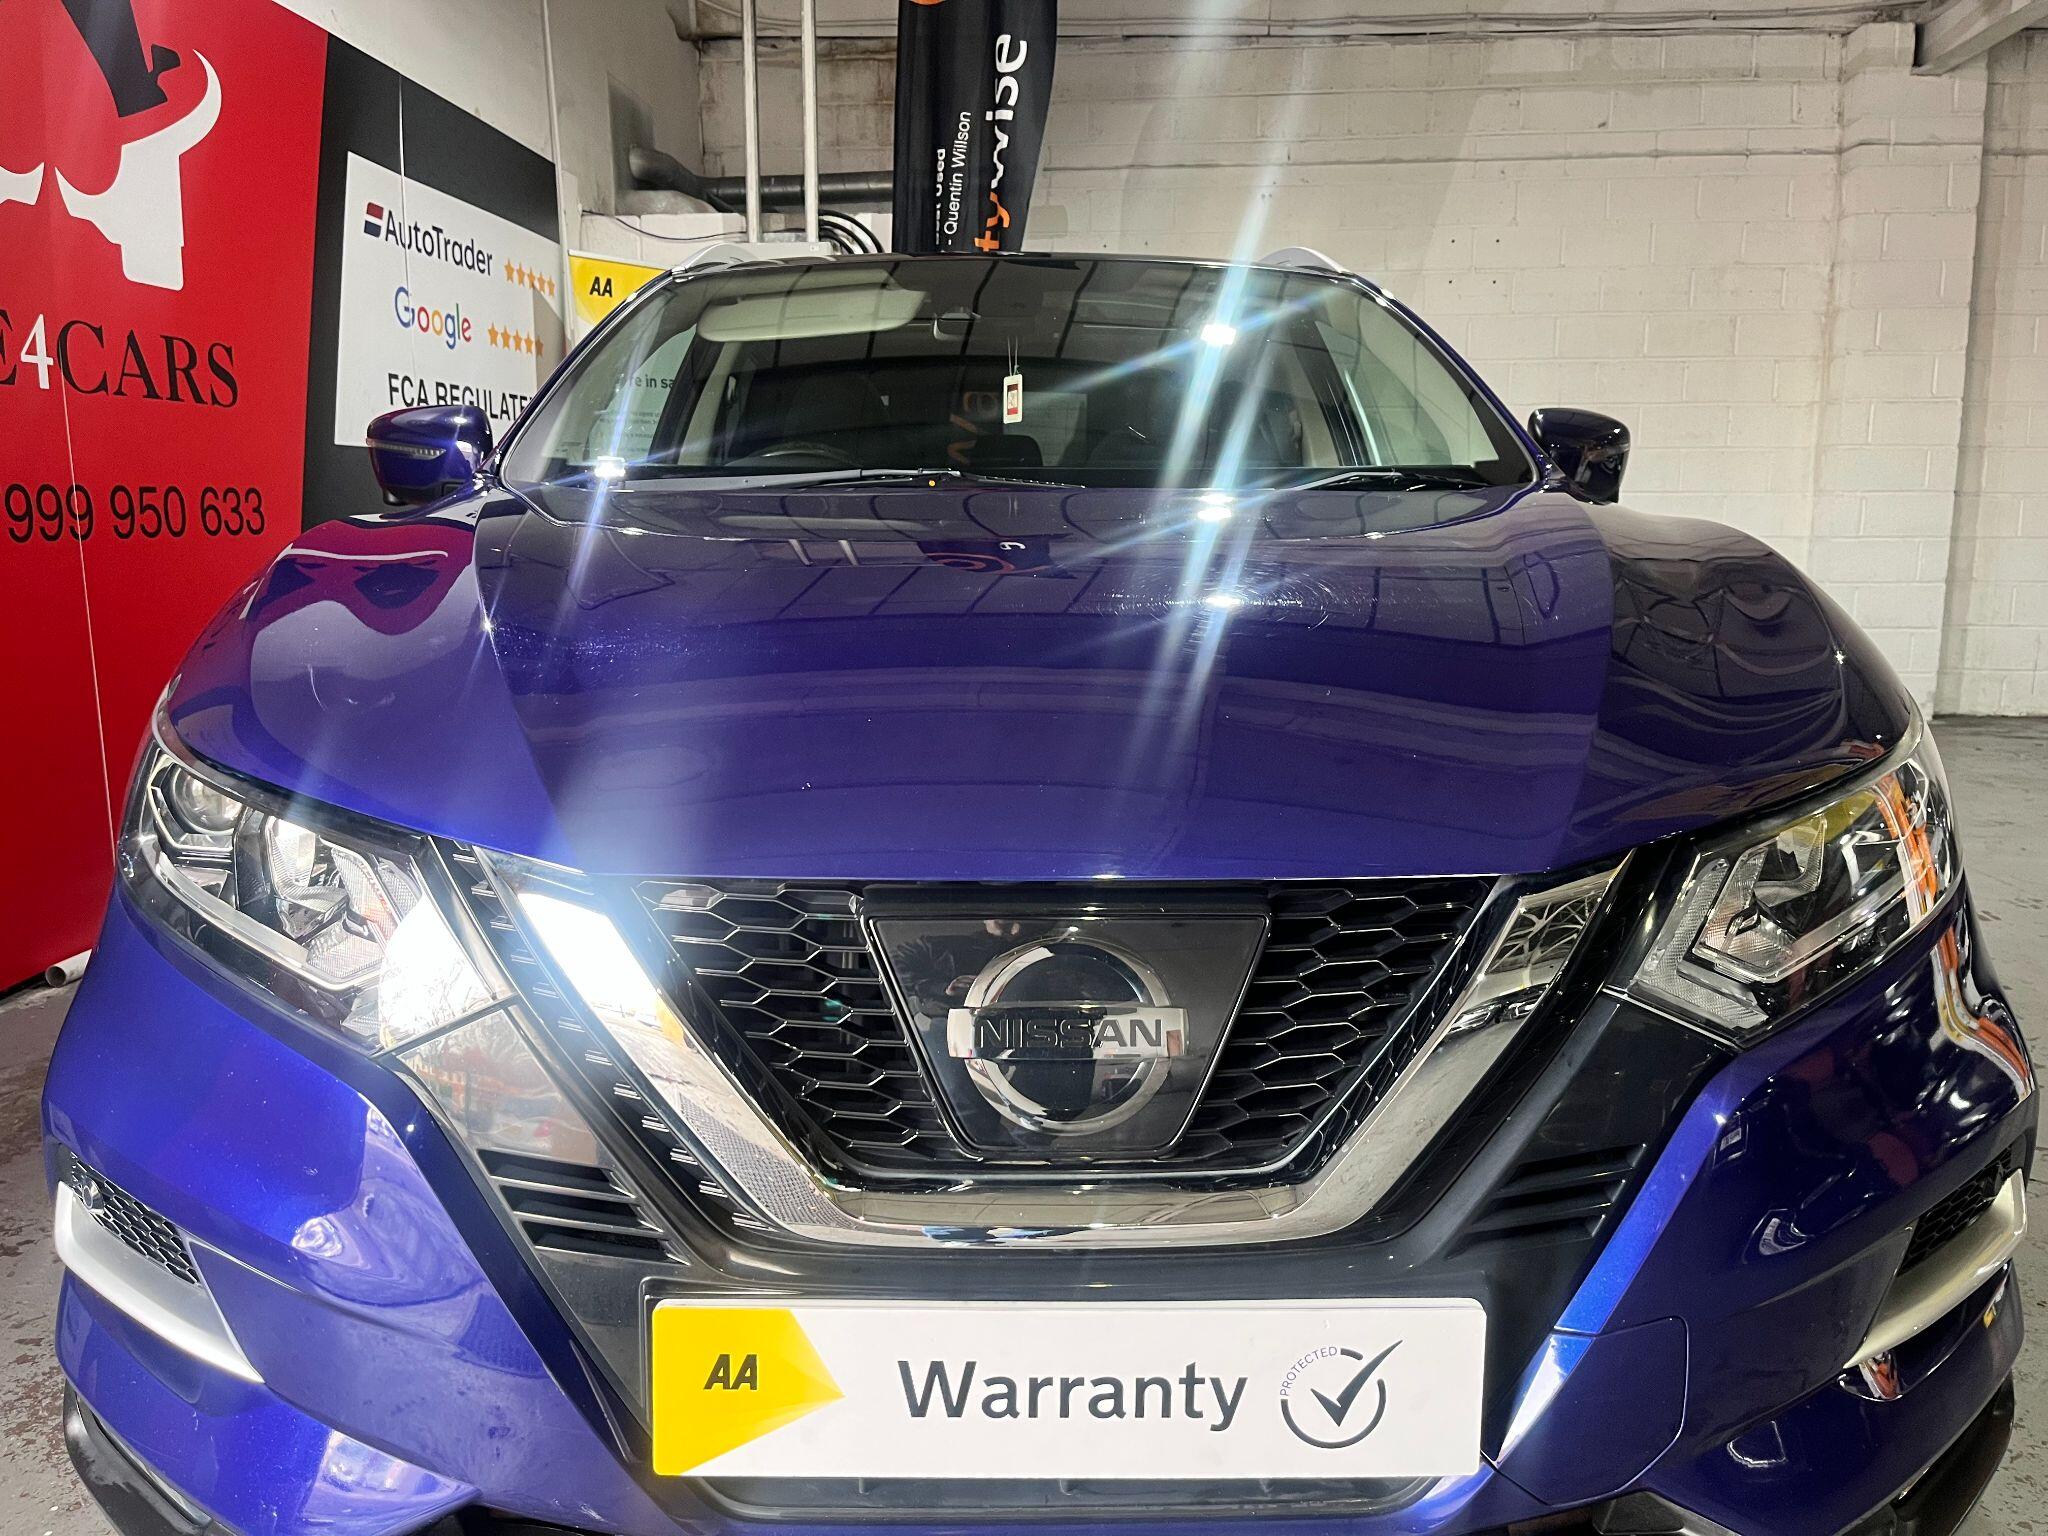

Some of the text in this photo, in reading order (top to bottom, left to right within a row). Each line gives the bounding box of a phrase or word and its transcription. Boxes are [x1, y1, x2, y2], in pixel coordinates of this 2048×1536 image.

[951, 111, 972, 168] Willson
[943, 172, 964, 235] Quentin
[385, 210, 493, 276] AutoTrader
[589, 275, 613, 298] AA
[394, 286, 472, 350] Google
[388, 372, 532, 421] FCA REGULATE
[4, 483, 266, 544] 999 950 633
[975, 1017, 1163, 1049] NISSAN
[703, 1353, 759, 1391] AA
[897, 1360, 1249, 1432] Warranty
[1279, 1346, 1338, 1397] PROTECTED
